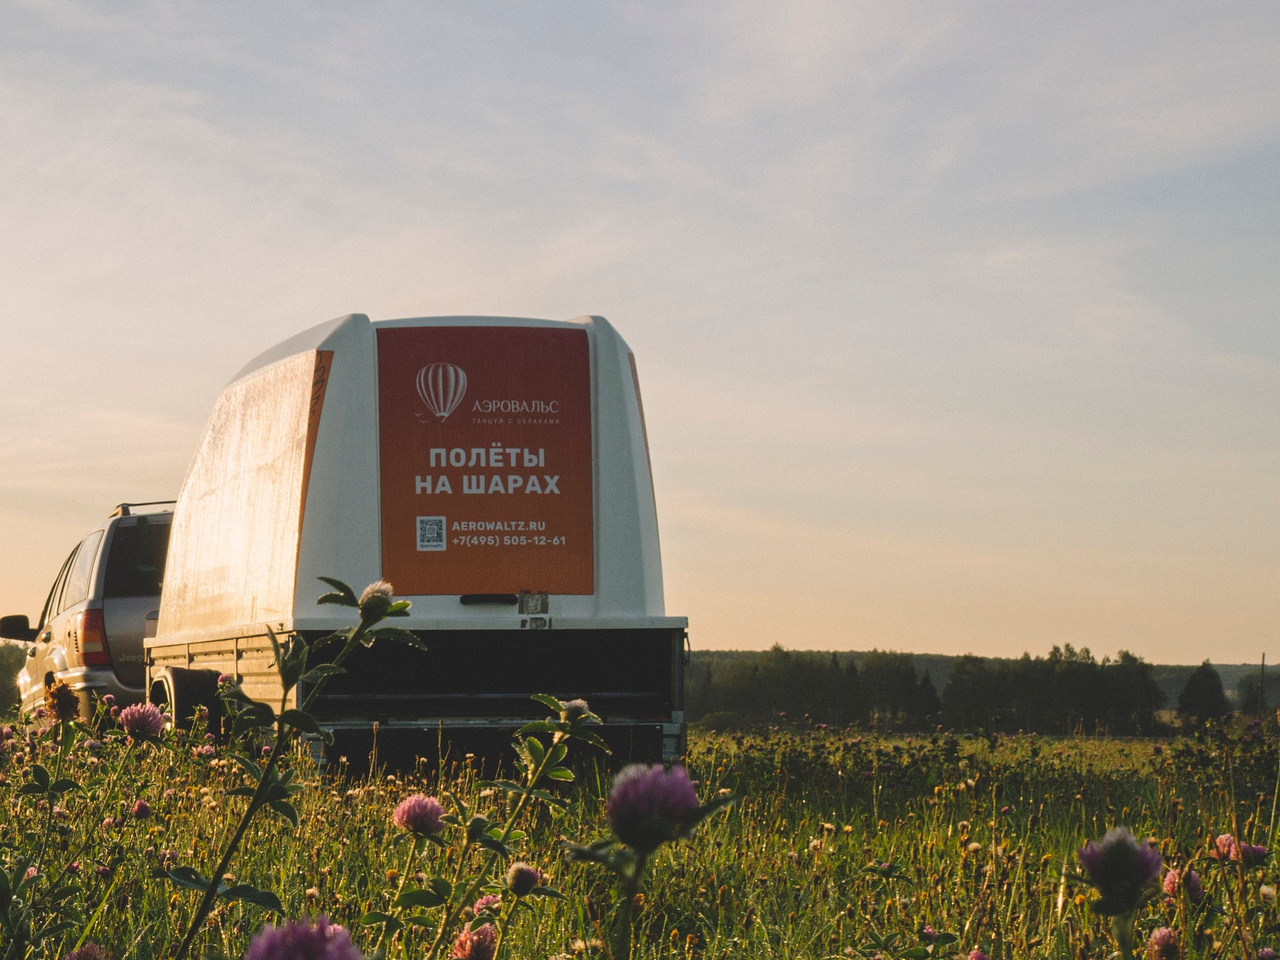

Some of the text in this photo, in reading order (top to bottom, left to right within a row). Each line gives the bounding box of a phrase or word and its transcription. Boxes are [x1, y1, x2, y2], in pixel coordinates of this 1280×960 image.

[472, 399, 559, 413] АЭРОВАЛЬС
[472, 417, 504, 425] ТАНЦУЙ
[516, 417, 560, 425] ОБЛАКАМИ
[429, 441, 546, 468] ПОЛЁТЫ
[414, 474, 561, 495] НА ШАРАХ
[451, 520, 547, 532] AEROWALTZ.RU
[451, 535, 500, 547] +7(495)
[503, 535, 567, 546] 505-12-61
[118, 653, 144, 664] Jeep
